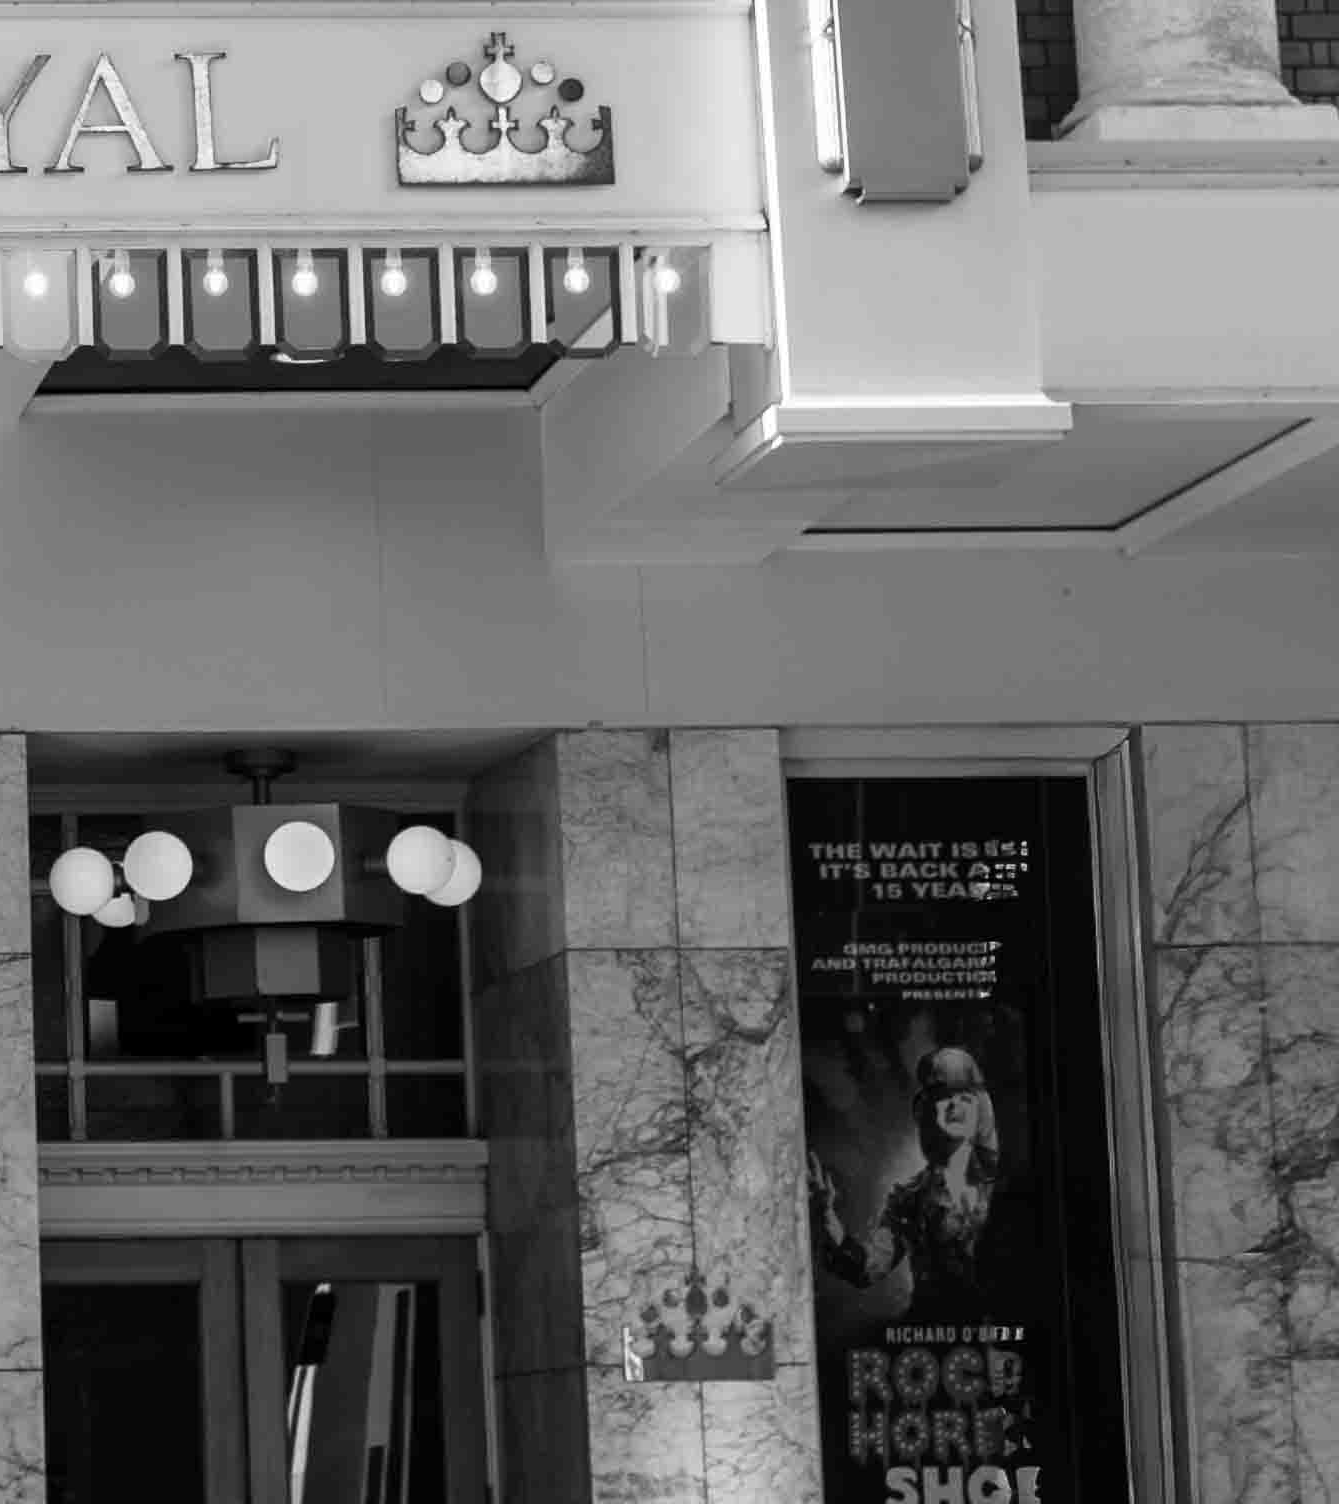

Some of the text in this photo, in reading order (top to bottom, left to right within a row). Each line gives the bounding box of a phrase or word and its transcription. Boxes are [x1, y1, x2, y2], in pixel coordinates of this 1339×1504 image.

[807, 842, 863, 860] THE
[869, 842, 943, 860] WAIT
[880, 863, 961, 880] BACK
[911, 882, 1019, 901] YEA
[849, 1348, 1023, 1400] ROC
